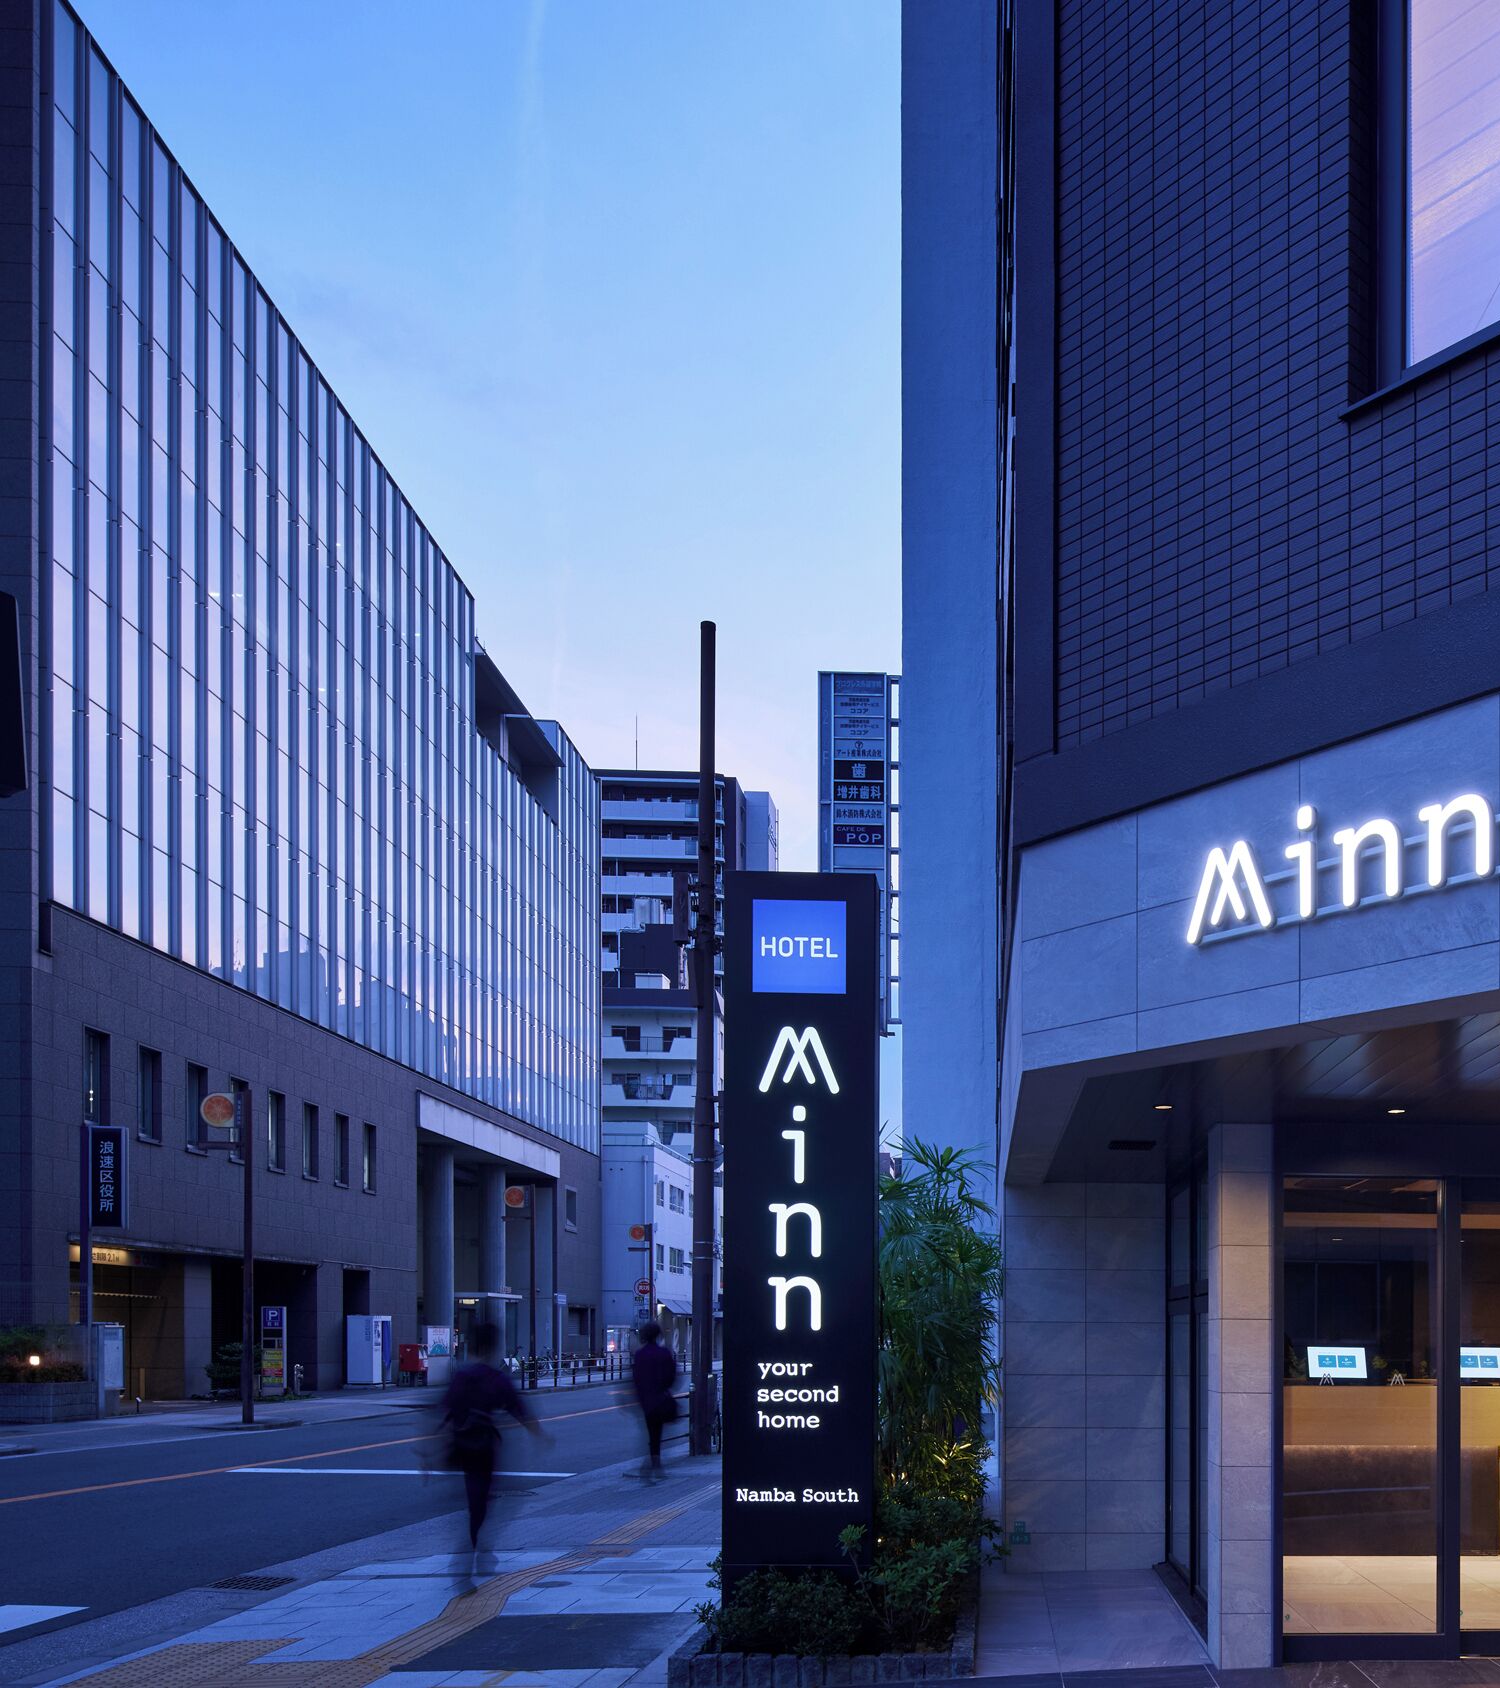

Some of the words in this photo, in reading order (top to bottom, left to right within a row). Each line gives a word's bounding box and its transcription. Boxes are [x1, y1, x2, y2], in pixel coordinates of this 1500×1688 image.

[851, 763, 867, 778] 歯
[837, 785, 881, 799] 増井歯科
[846, 833, 881, 843] POP
[1186, 791, 1496, 945] Minn
[761, 936, 838, 958] HOTEL
[99, 1141, 114, 1212] 浪速区役所
[758, 1026, 840, 1331] Minn
[757, 1362, 812, 1378] your
[757, 1386, 839, 1403] second
[757, 1410, 820, 1429] home
[736, 1487, 797, 1503] Namba
[802, 1487, 860, 1503] South
